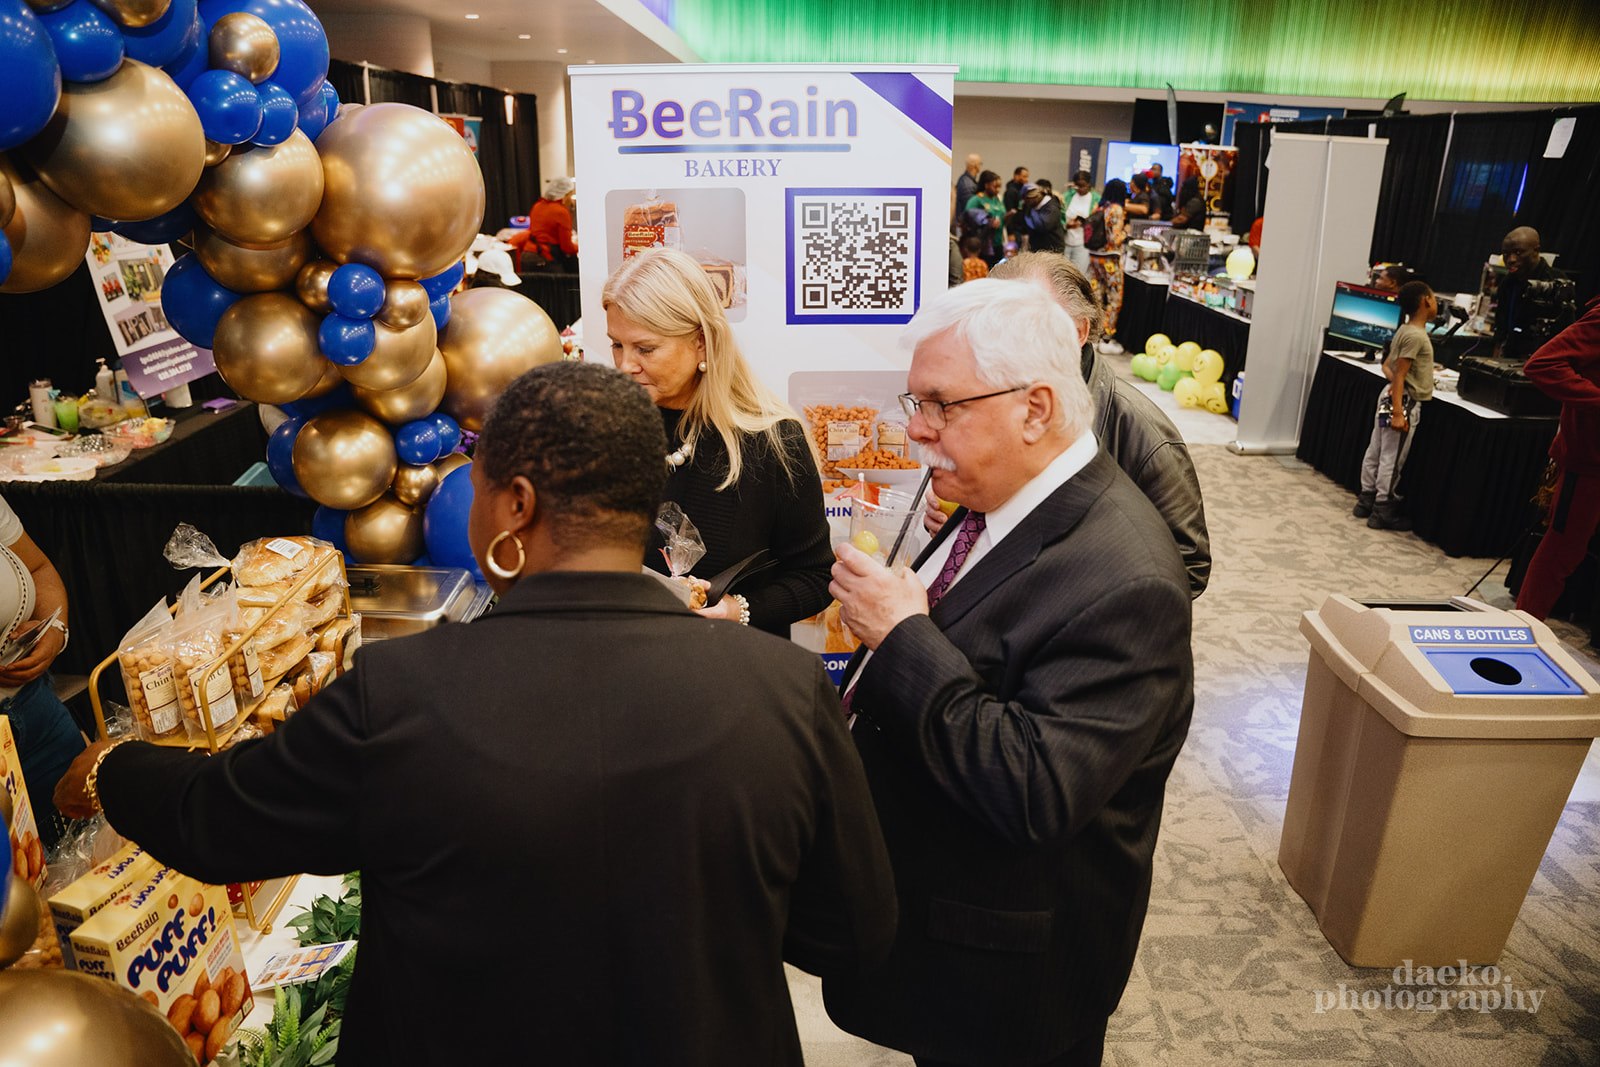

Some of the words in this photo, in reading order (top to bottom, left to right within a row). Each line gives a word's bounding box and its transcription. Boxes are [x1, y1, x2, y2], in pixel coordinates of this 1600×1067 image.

[608, 85, 858, 139] BeeRain
[684, 158, 782, 178] BAKERY
[825, 506, 852, 517] HIN
[1413, 629, 1451, 640] CANS
[1454, 629, 1464, 640] &
[1466, 629, 1528, 641] BOTTLES
[145, 676, 169, 690] Chin
[115, 911, 160, 952] BeeRain
[73, 942, 111, 957] BeeRain
[127, 908, 185, 989] PUFF
[157, 906, 216, 993] PUFF!
[79, 960, 105, 972] PUFF
